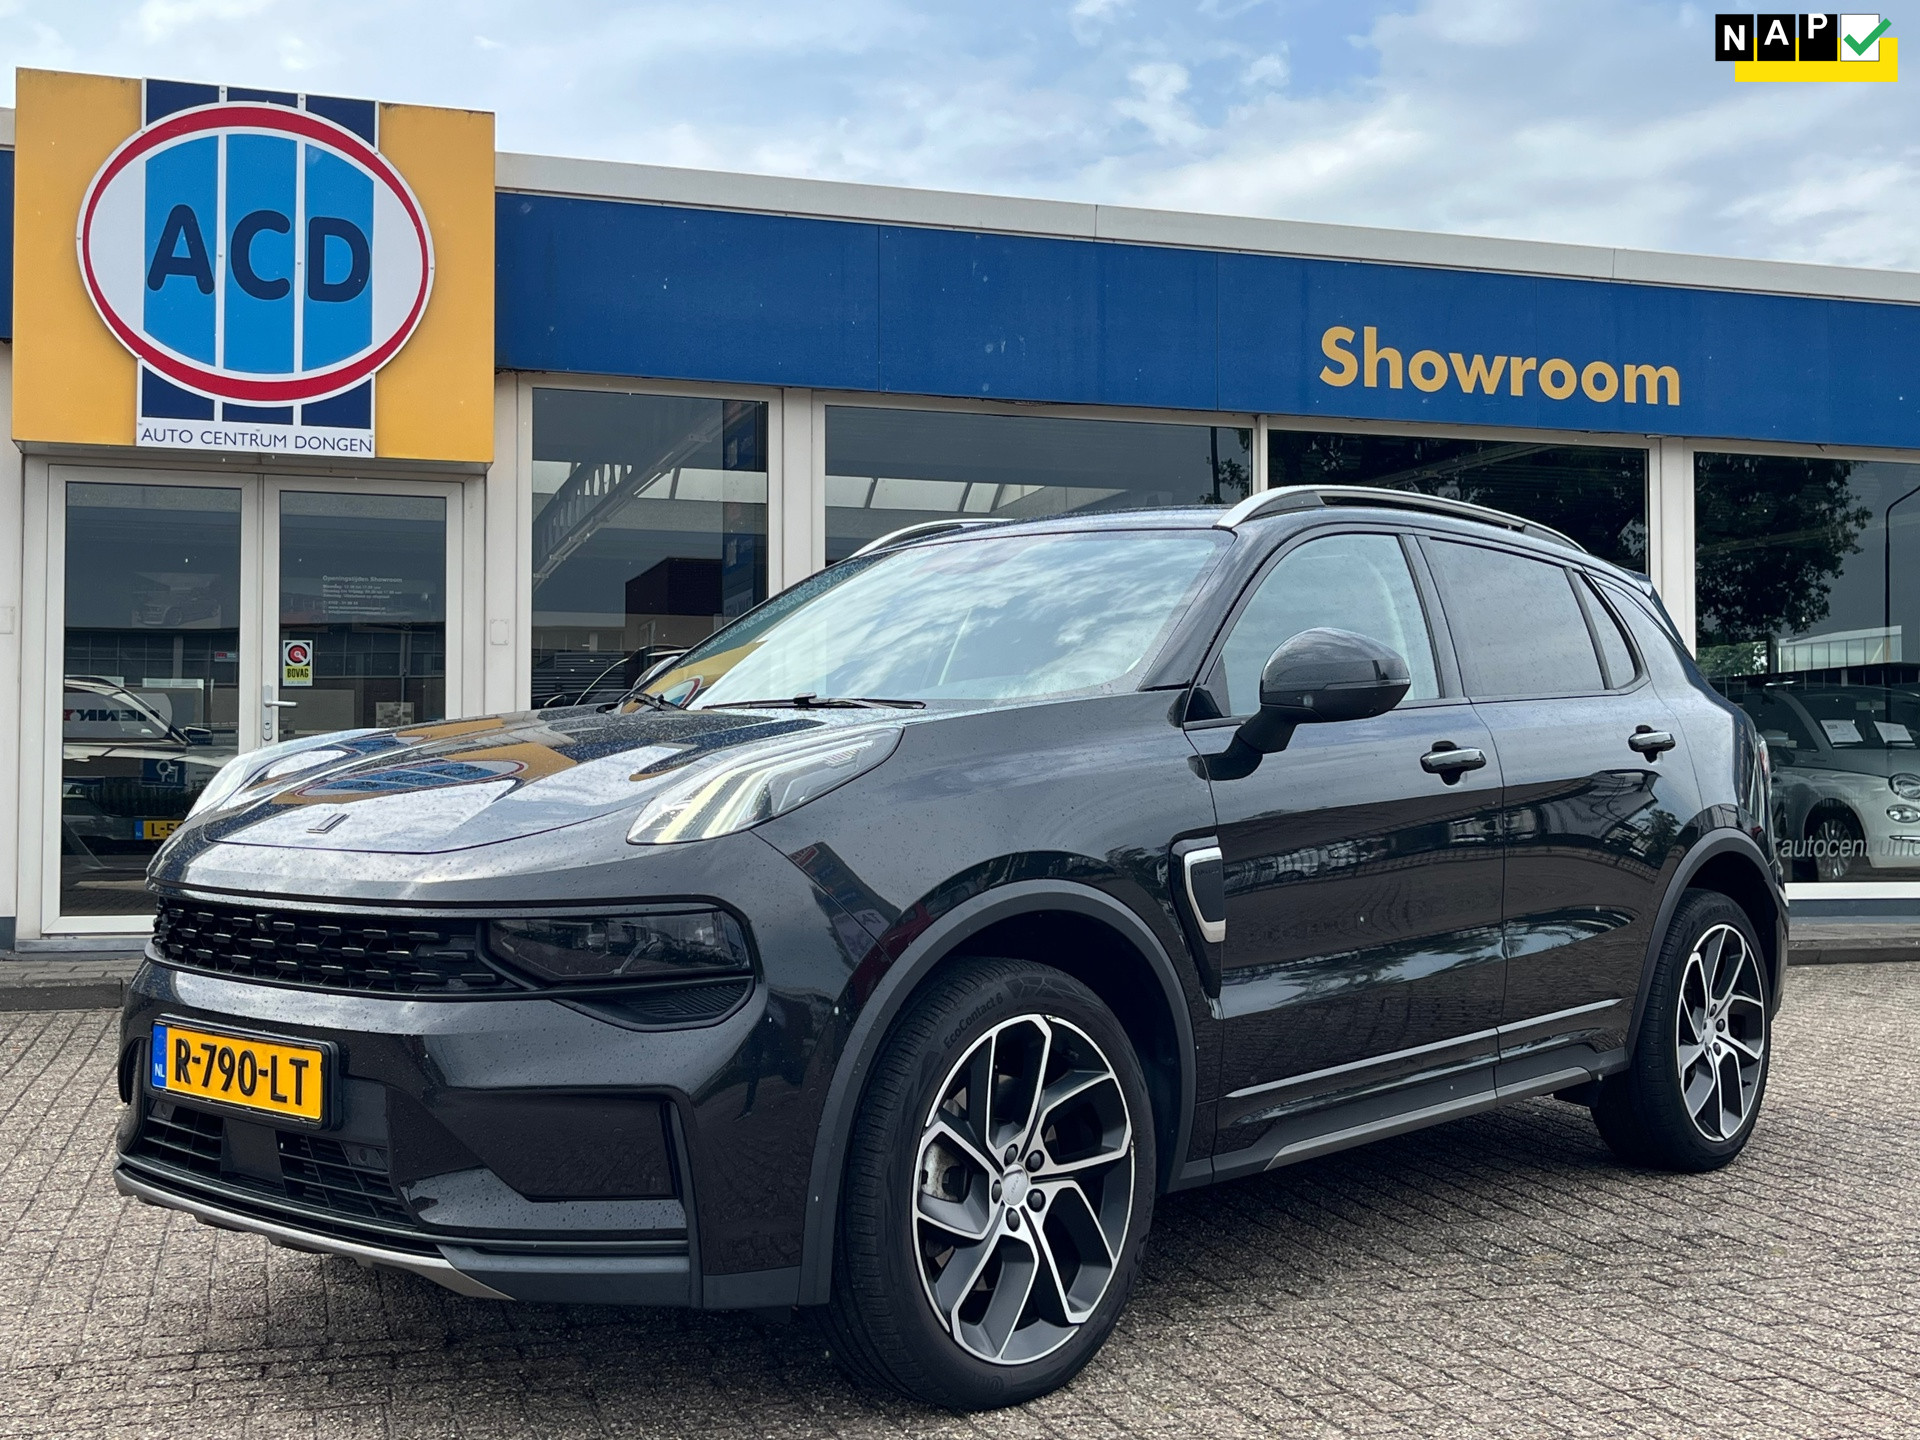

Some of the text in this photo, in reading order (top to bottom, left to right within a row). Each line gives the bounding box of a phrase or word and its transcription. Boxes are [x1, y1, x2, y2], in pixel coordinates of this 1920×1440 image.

[147, 204, 371, 302] ACD
[1318, 325, 1681, 406] Showroom
[140, 427, 373, 453] AUTO CENTRUM DONGEN
[286, 667, 309, 679] BOVAG
[154, 1062, 166, 1078] NL
[175, 1037, 309, 1107] R-790-LT
